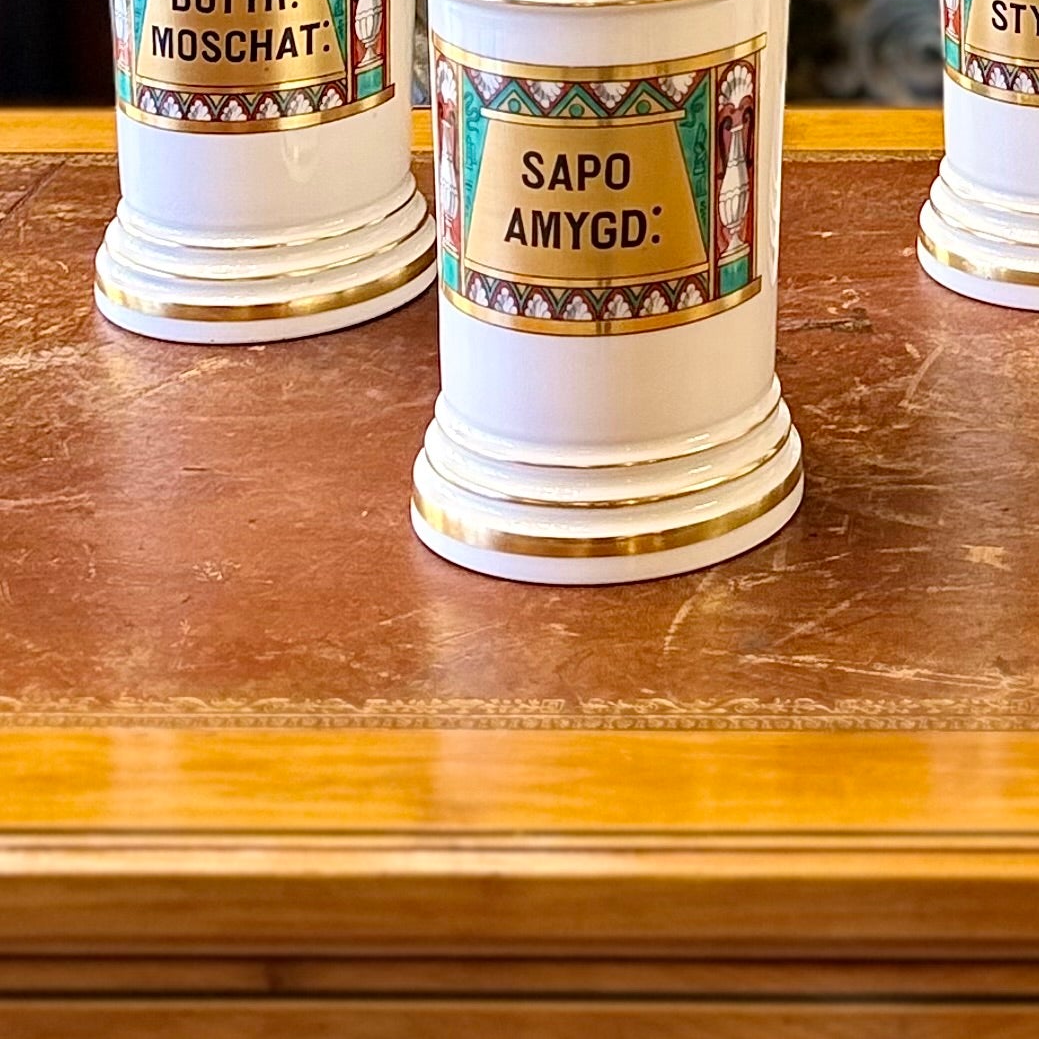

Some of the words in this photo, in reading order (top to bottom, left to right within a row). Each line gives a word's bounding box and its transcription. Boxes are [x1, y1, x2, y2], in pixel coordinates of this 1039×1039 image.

[151, 20, 330, 63] MOSCHAT:
[521, 150, 631, 192] SAPO
[503, 205, 662, 250] AMYGD:
